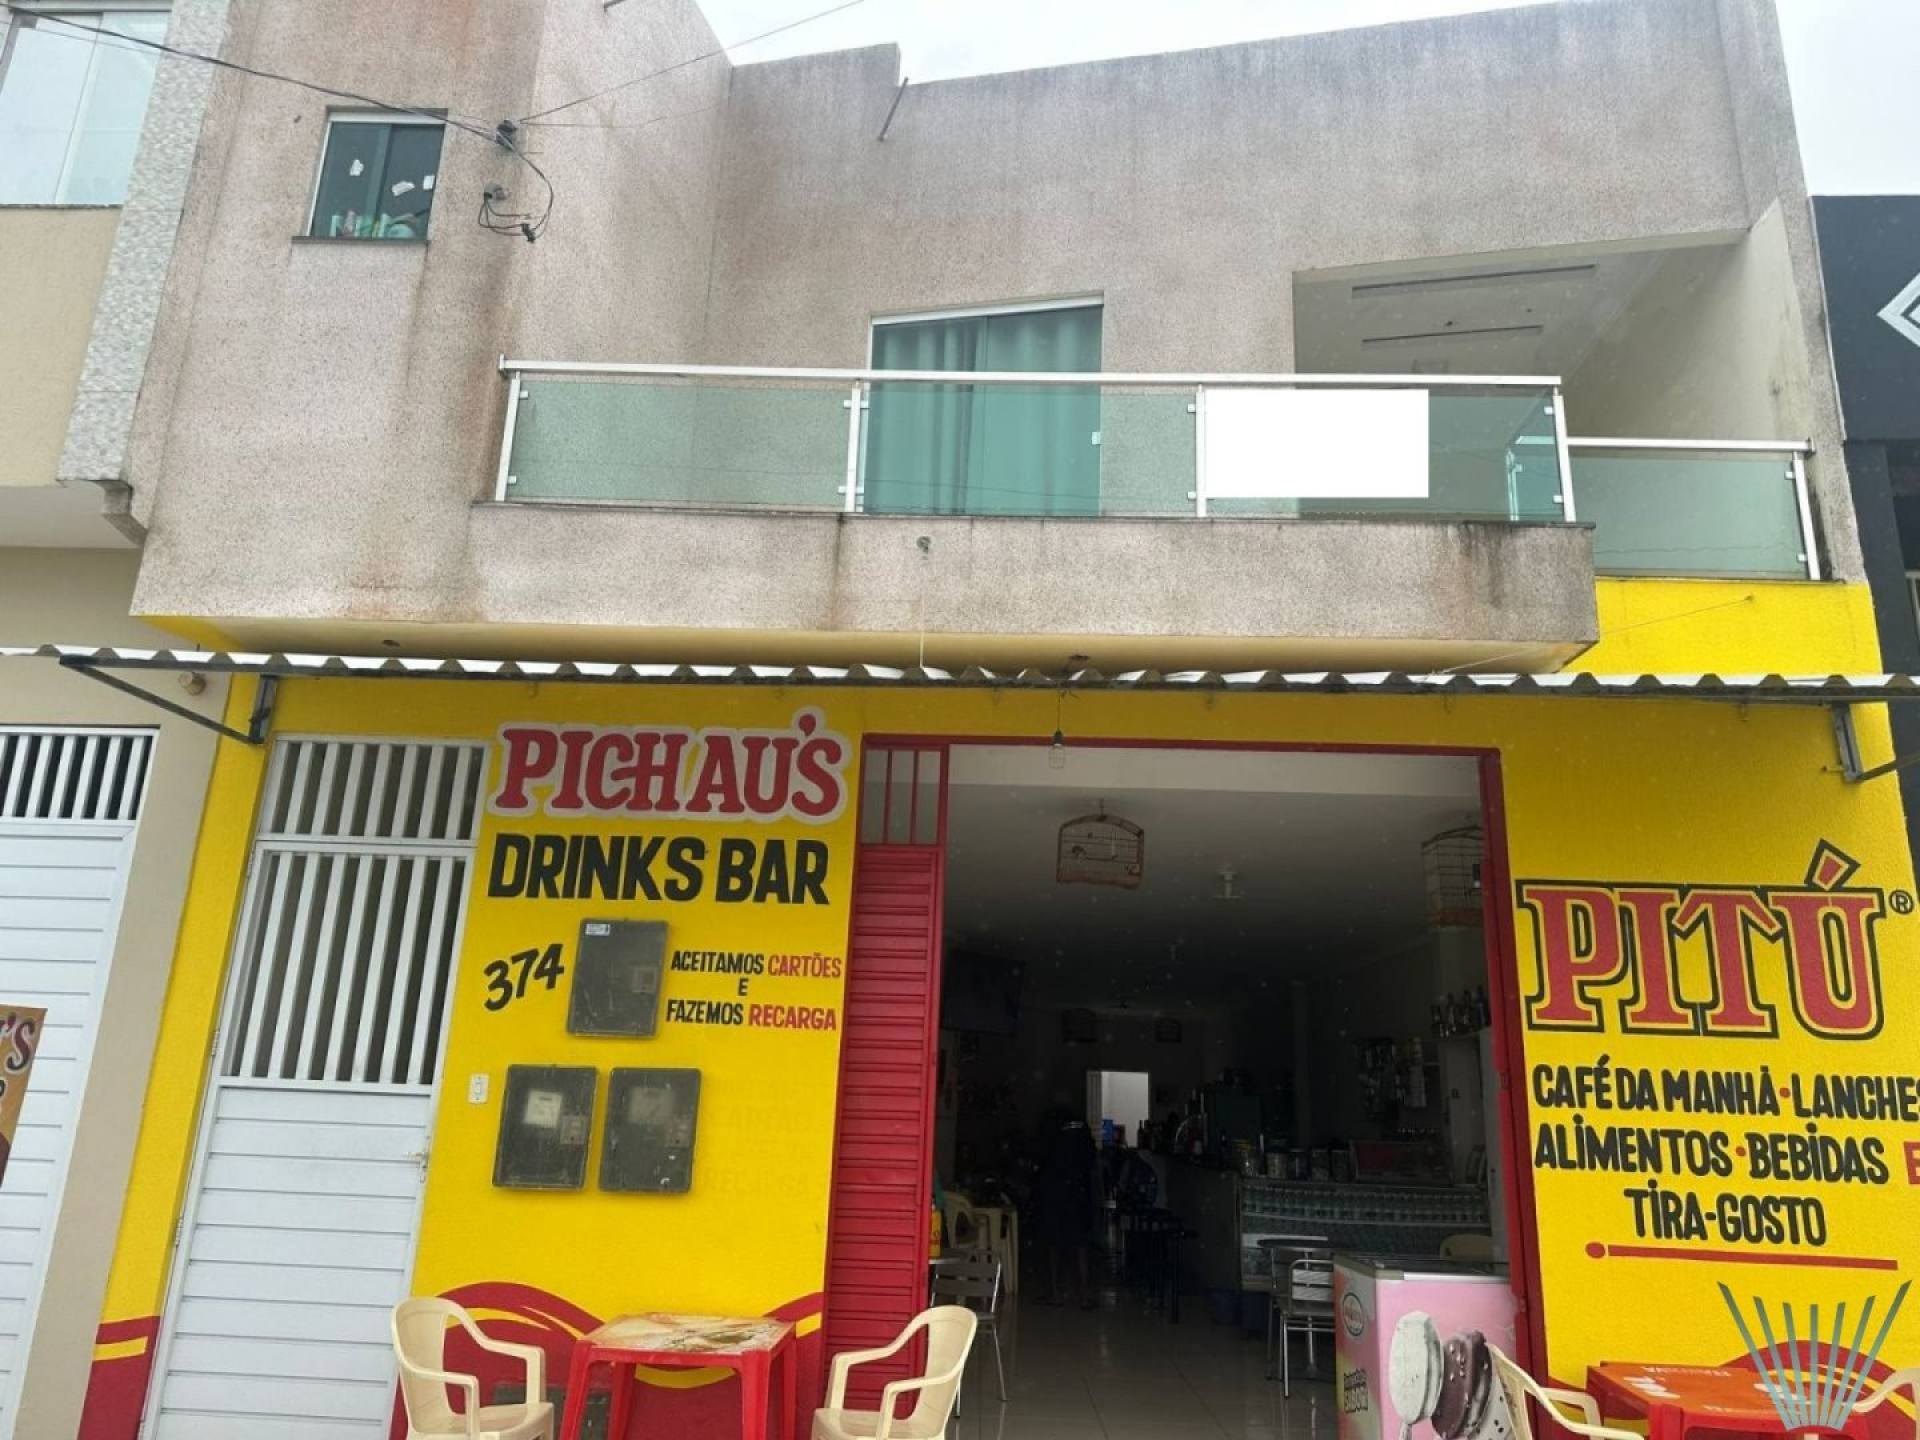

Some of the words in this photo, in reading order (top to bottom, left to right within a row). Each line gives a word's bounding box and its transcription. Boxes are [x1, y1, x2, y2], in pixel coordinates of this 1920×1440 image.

[495, 713, 843, 817] PICHAU'S
[488, 833, 706, 901] DRINKS
[715, 838, 830, 905] BAR
[671, 950, 764, 975] ACEITAMOS
[768, 953, 842, 978] CARTÕES
[1516, 839, 1887, 1040] PITÚ
[483, 943, 565, 1012] 374
[737, 978, 749, 996] E
[666, 999, 744, 1025] FAZEMOS
[748, 1003, 837, 1030] RECARGA
[1533, 1054, 1612, 1109] CAFÉ
[1615, 1067, 1659, 1112] DA
